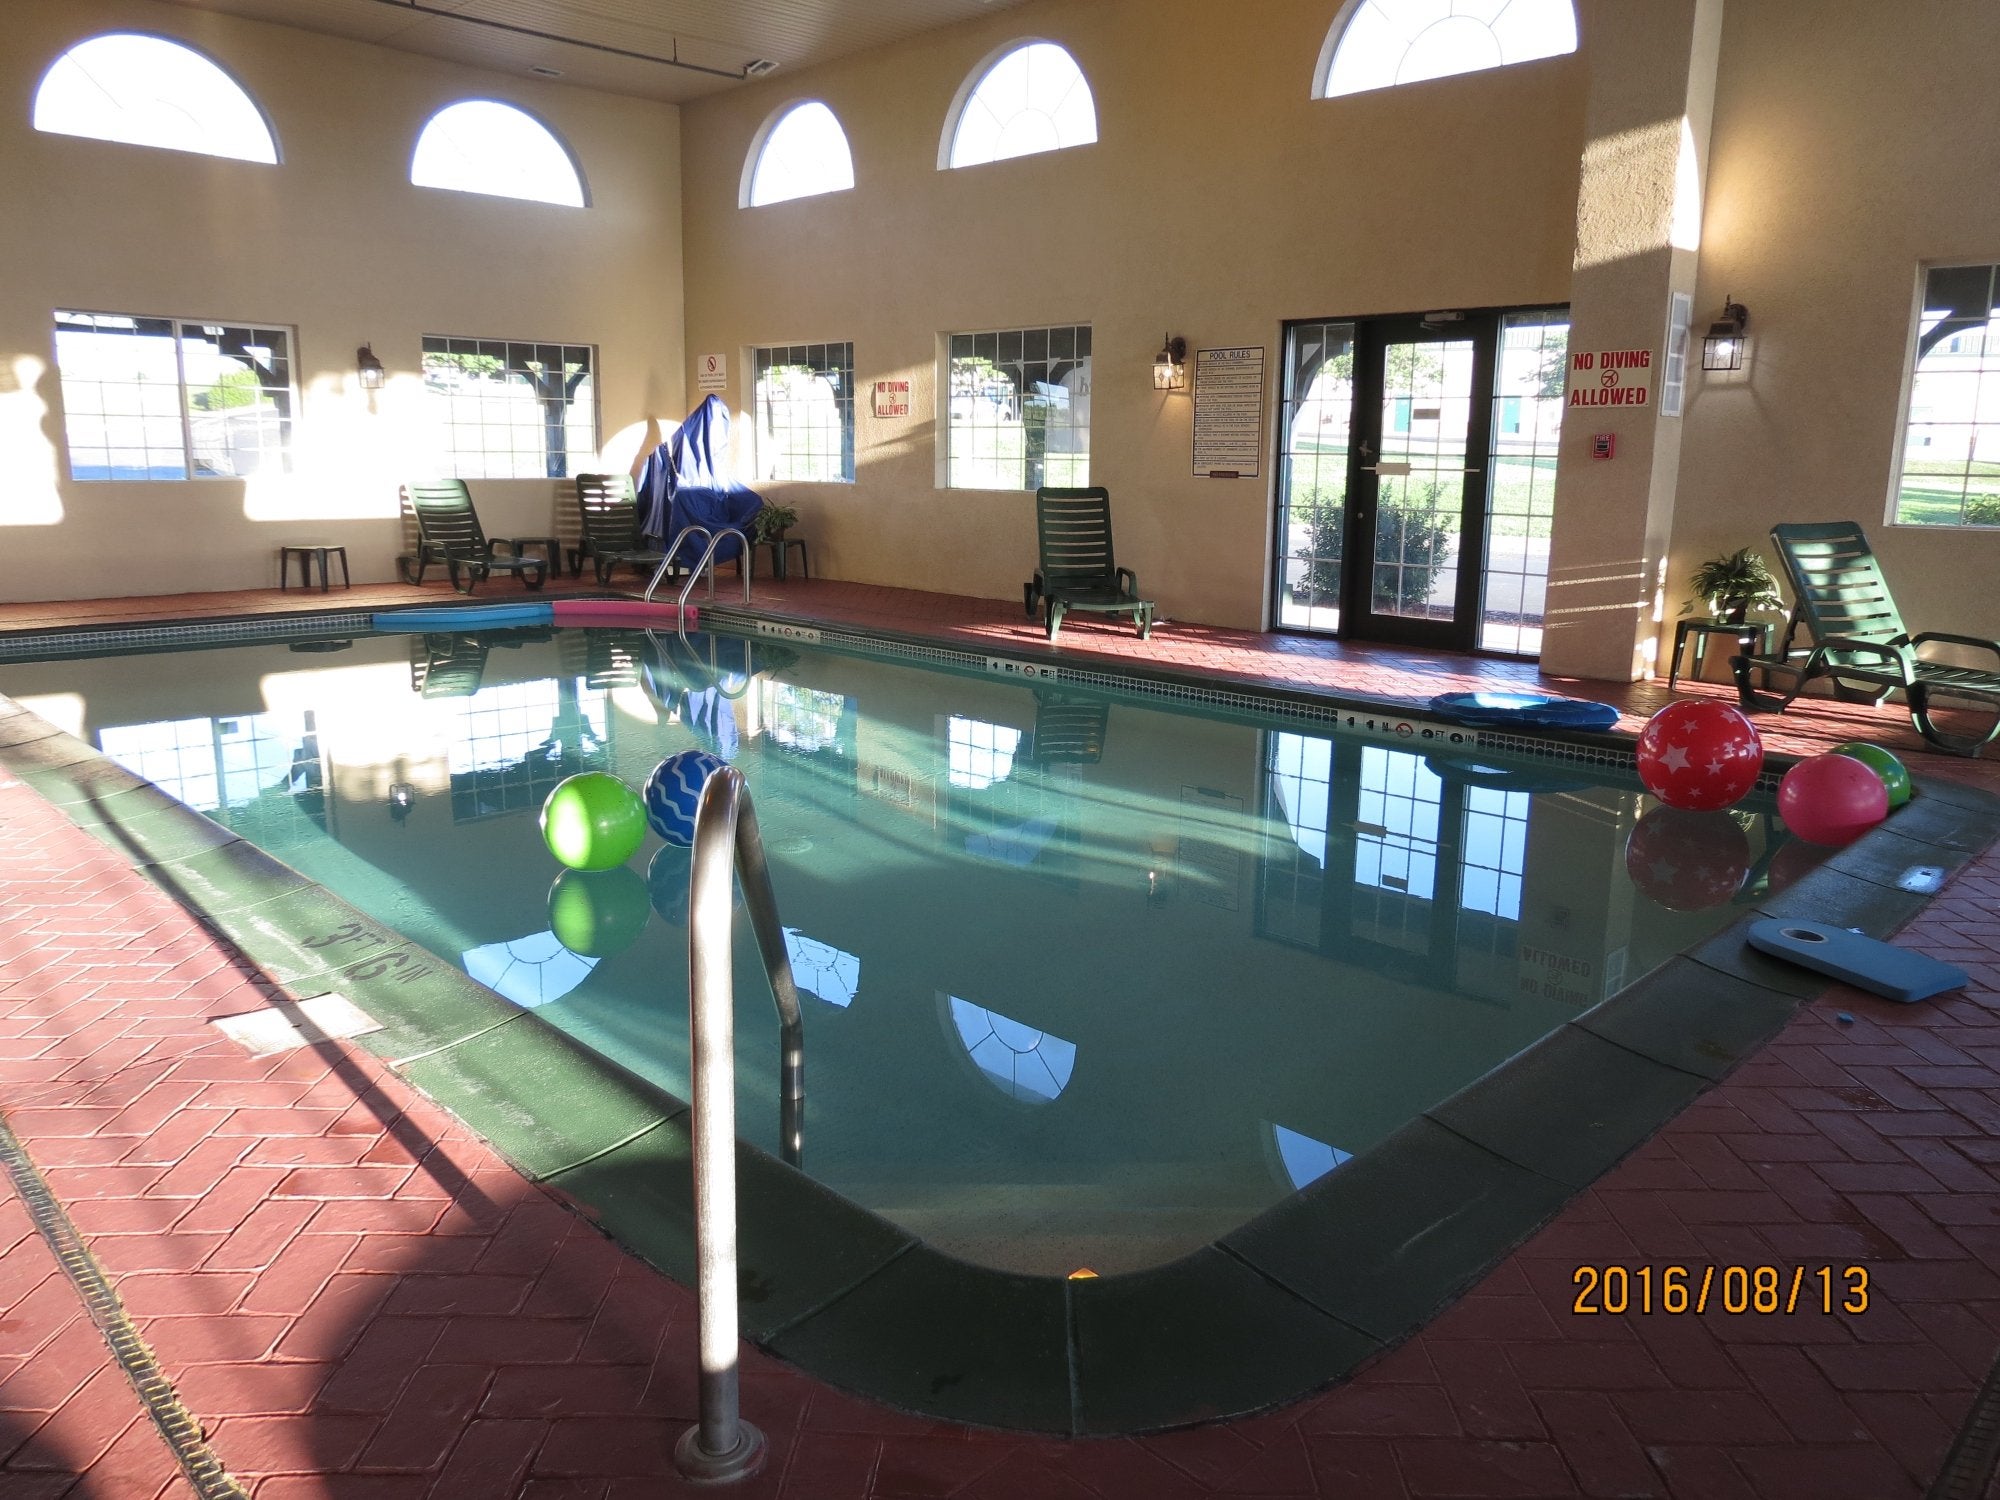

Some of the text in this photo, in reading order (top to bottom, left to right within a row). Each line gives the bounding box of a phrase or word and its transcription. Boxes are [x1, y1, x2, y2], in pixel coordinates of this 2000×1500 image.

[1573, 350, 1650, 370] NO DIVING
[877, 381, 909, 392] NO DIVING
[1570, 387, 1647, 406] ALLOWED
[877, 404, 909, 415] ALLOWED
